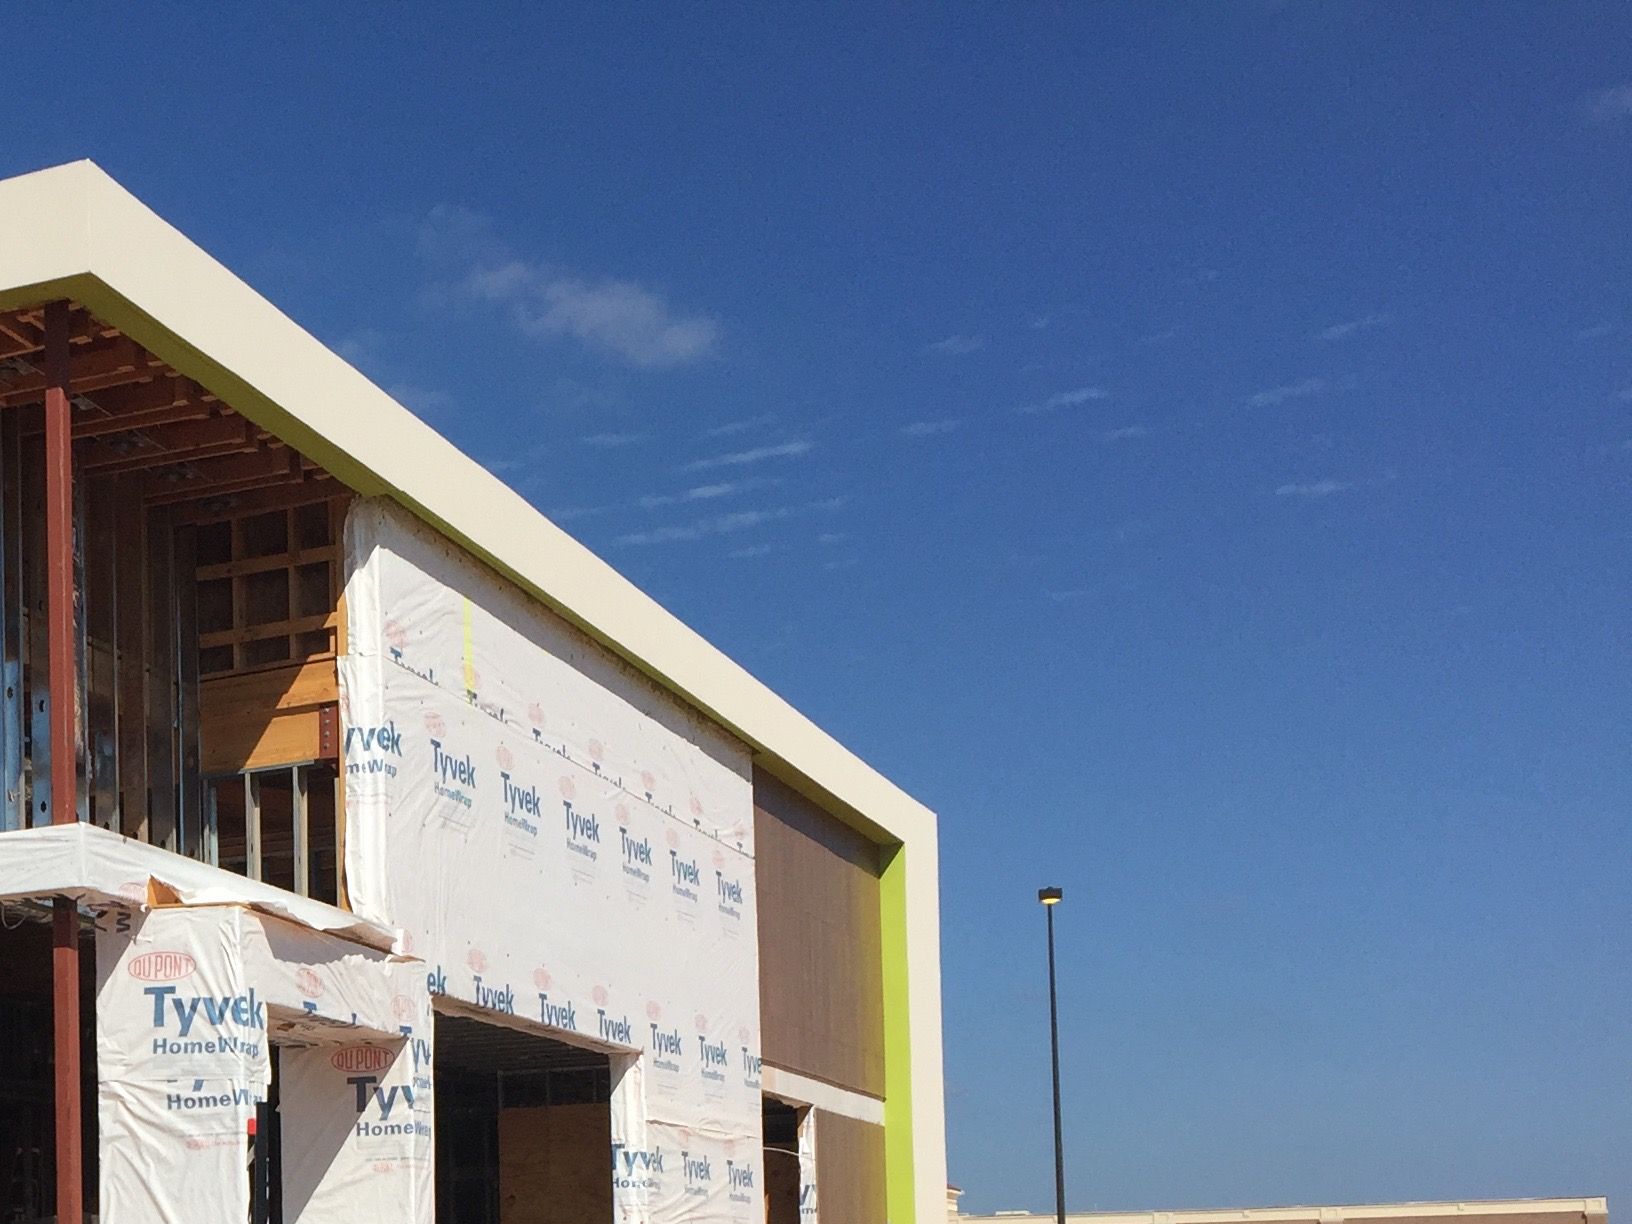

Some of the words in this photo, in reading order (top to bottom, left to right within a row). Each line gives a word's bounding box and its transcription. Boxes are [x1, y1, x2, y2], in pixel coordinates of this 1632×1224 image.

[430, 738, 476, 789] Tyvek
[500, 771, 541, 818] Tyvek
[563, 799, 600, 844] Tyvek
[619, 826, 653, 866] Tyvek
[669, 849, 700, 887] Tyvek
[715, 870, 743, 905] Tyvek
[143, 985, 265, 1038] Tyvek
[539, 993, 577, 1031] Tyvek
[597, 1008, 632, 1044] Tyvek
[650, 1023, 682, 1058] Tyvek
[698, 1035, 728, 1067] Tyvek
[681, 1151, 711, 1185] Tyvek
[726, 1159, 754, 1191] Tyvek
